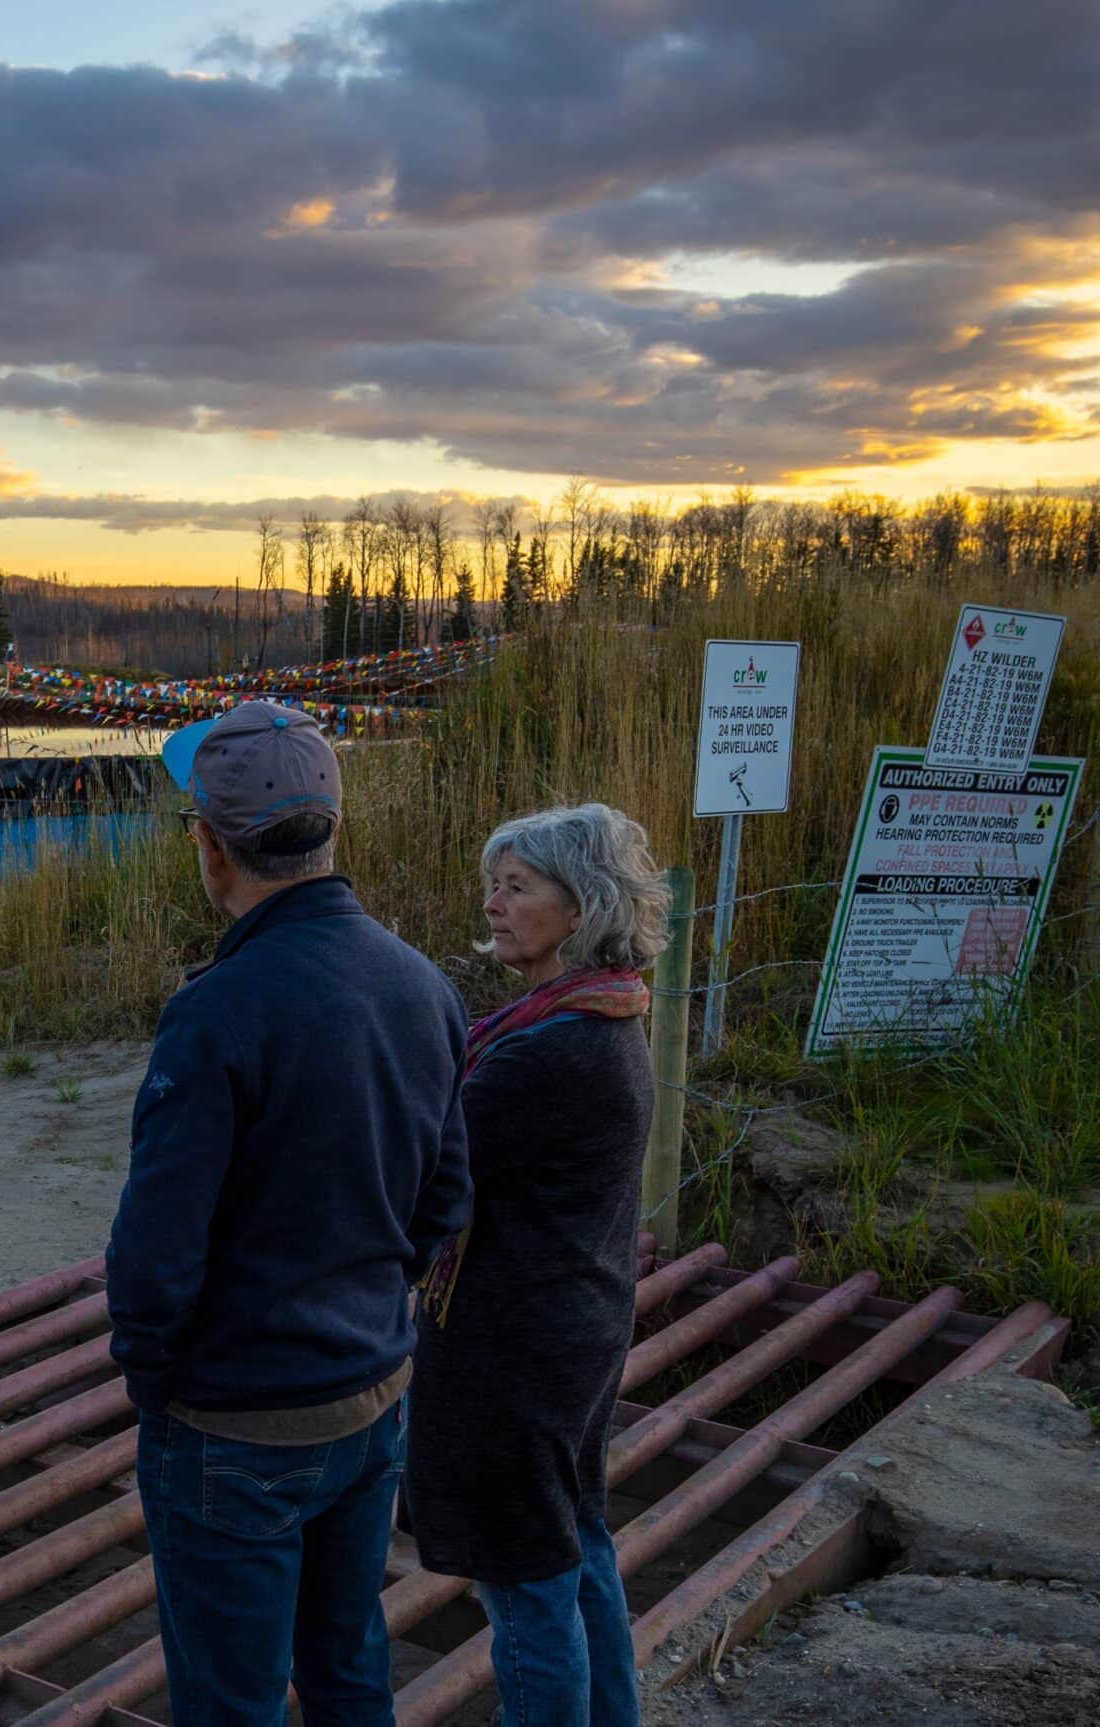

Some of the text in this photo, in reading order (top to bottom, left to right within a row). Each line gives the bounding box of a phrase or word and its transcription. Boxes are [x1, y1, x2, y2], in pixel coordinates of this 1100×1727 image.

[972, 650, 1036, 668] HZ WILDER
[733, 669, 768, 683] crew
[959, 664, 1044, 682] 4-21-82-19 W6M
[949, 674, 1041, 693] A4-21-82-19 W6M
[948, 686, 1038, 704] B4-21-82-19 W6M
[708, 706, 788, 719] THIS AREA UNDER
[944, 698, 1035, 716] C4-21-82-19 W6M
[942, 709, 1032, 727] D4-21-82-19 W6M
[718, 723, 774, 736] 24 HR VIDEO
[939, 720, 1030, 738] E4-21-82-19 W6M
[711, 740, 779, 754] SURVEILLANCE
[936, 731, 1027, 748] F4-21-82-19 W6M
[999, 748, 1025, 760] W6M
[884, 769, 1066, 794] AUTHORIZED ENTRY ONLY
[908, 793, 1028, 815] PPE REQUIRED
[910, 814, 1019, 829] MAY CONTAIN NORMS
[876, 828, 1044, 845] HEARING PROTECTION REQUIRED
[897, 844, 922, 856] FALL
[924, 845, 992, 858] PROTECTION
[876, 860, 928, 872] CONFINED
[931, 861, 970, 874] SPACES
[877, 877, 1018, 894] LOADING PROCEDURE
